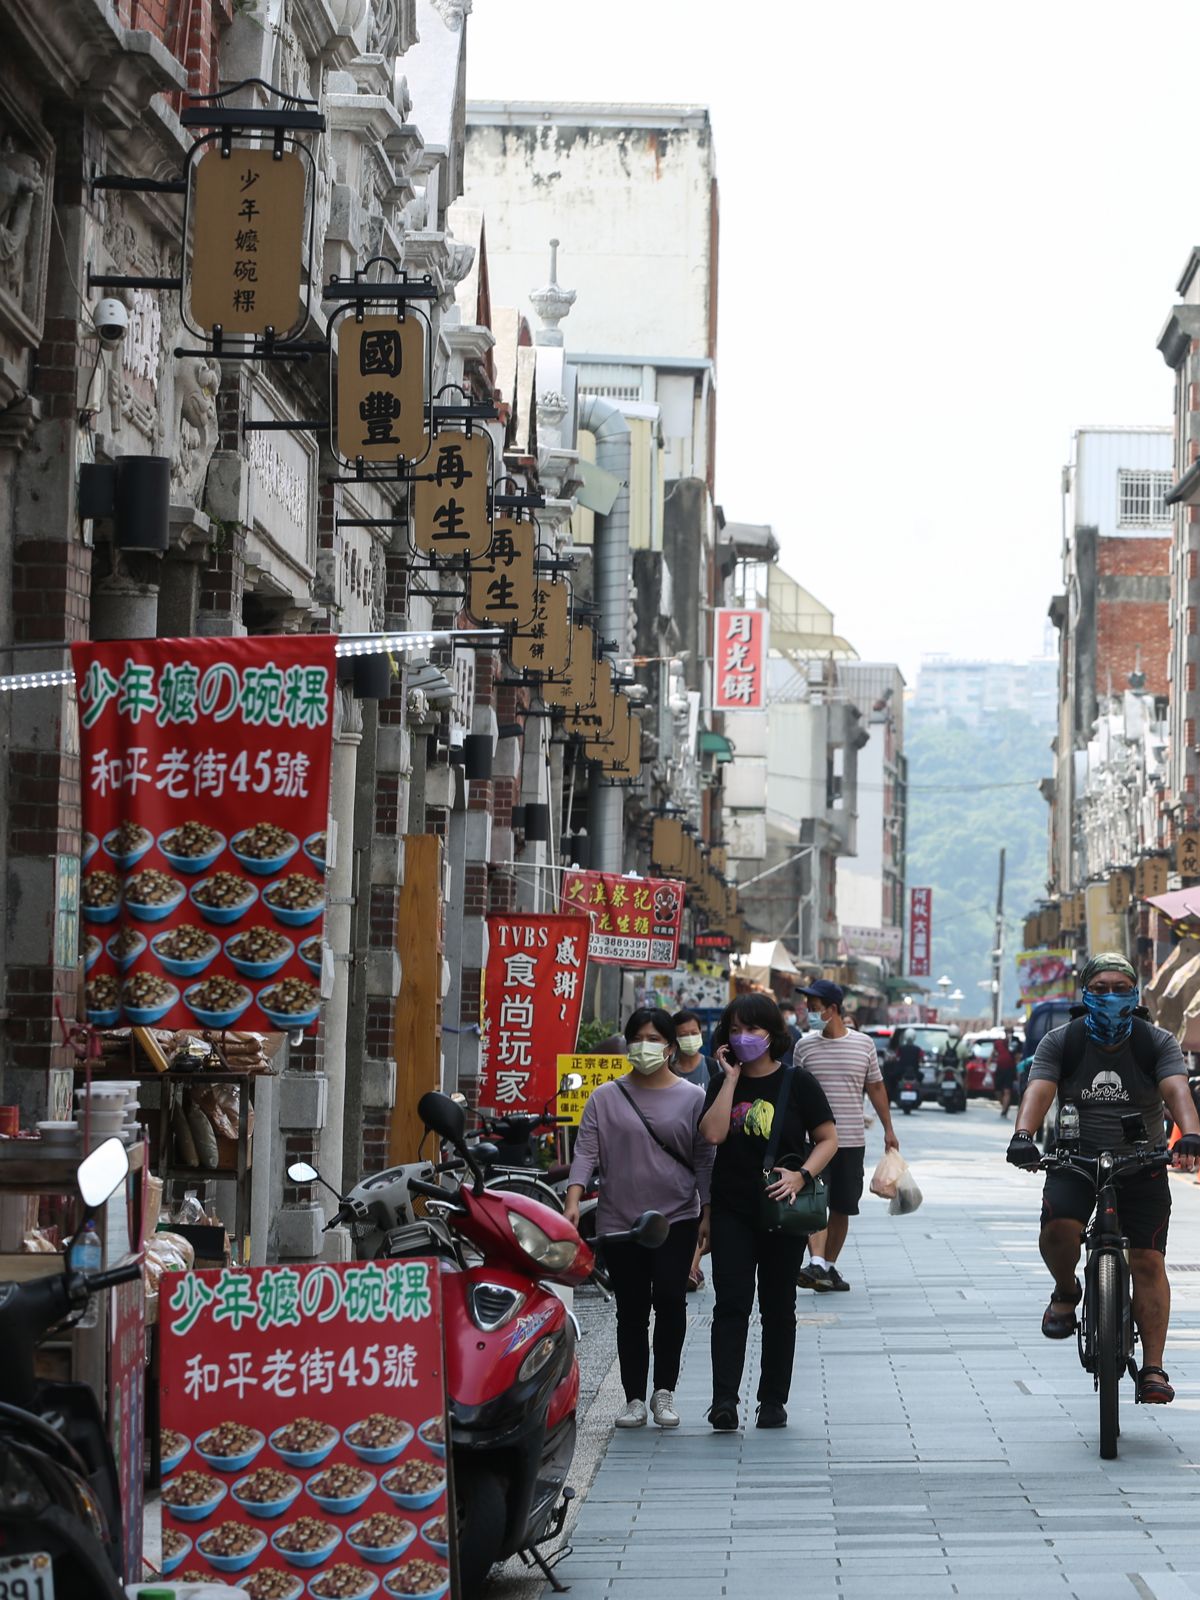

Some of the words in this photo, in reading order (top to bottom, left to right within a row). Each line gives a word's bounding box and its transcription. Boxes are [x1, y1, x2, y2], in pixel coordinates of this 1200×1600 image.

[233, 168, 261, 313] 少年嬤碗粿
[359, 329, 401, 447] 國豐
[432, 445, 472, 541] 再生
[485, 528, 522, 611] 再生
[80, 658, 330, 730] 少年嬤の碗粿
[721, 613, 757, 706] 月光餅
[90, 747, 311, 799] 和平老街45號
[567, 878, 652, 911] 大溪蔡記
[498, 925, 549, 948] TVBS
[495, 952, 538, 1105] 食尚玩家
[571, 1057, 623, 1070] 正宗老店
[170, 1261, 433, 1337] 少年嬤の碗粿
[184, 1344, 420, 1400] 和平老街45號
